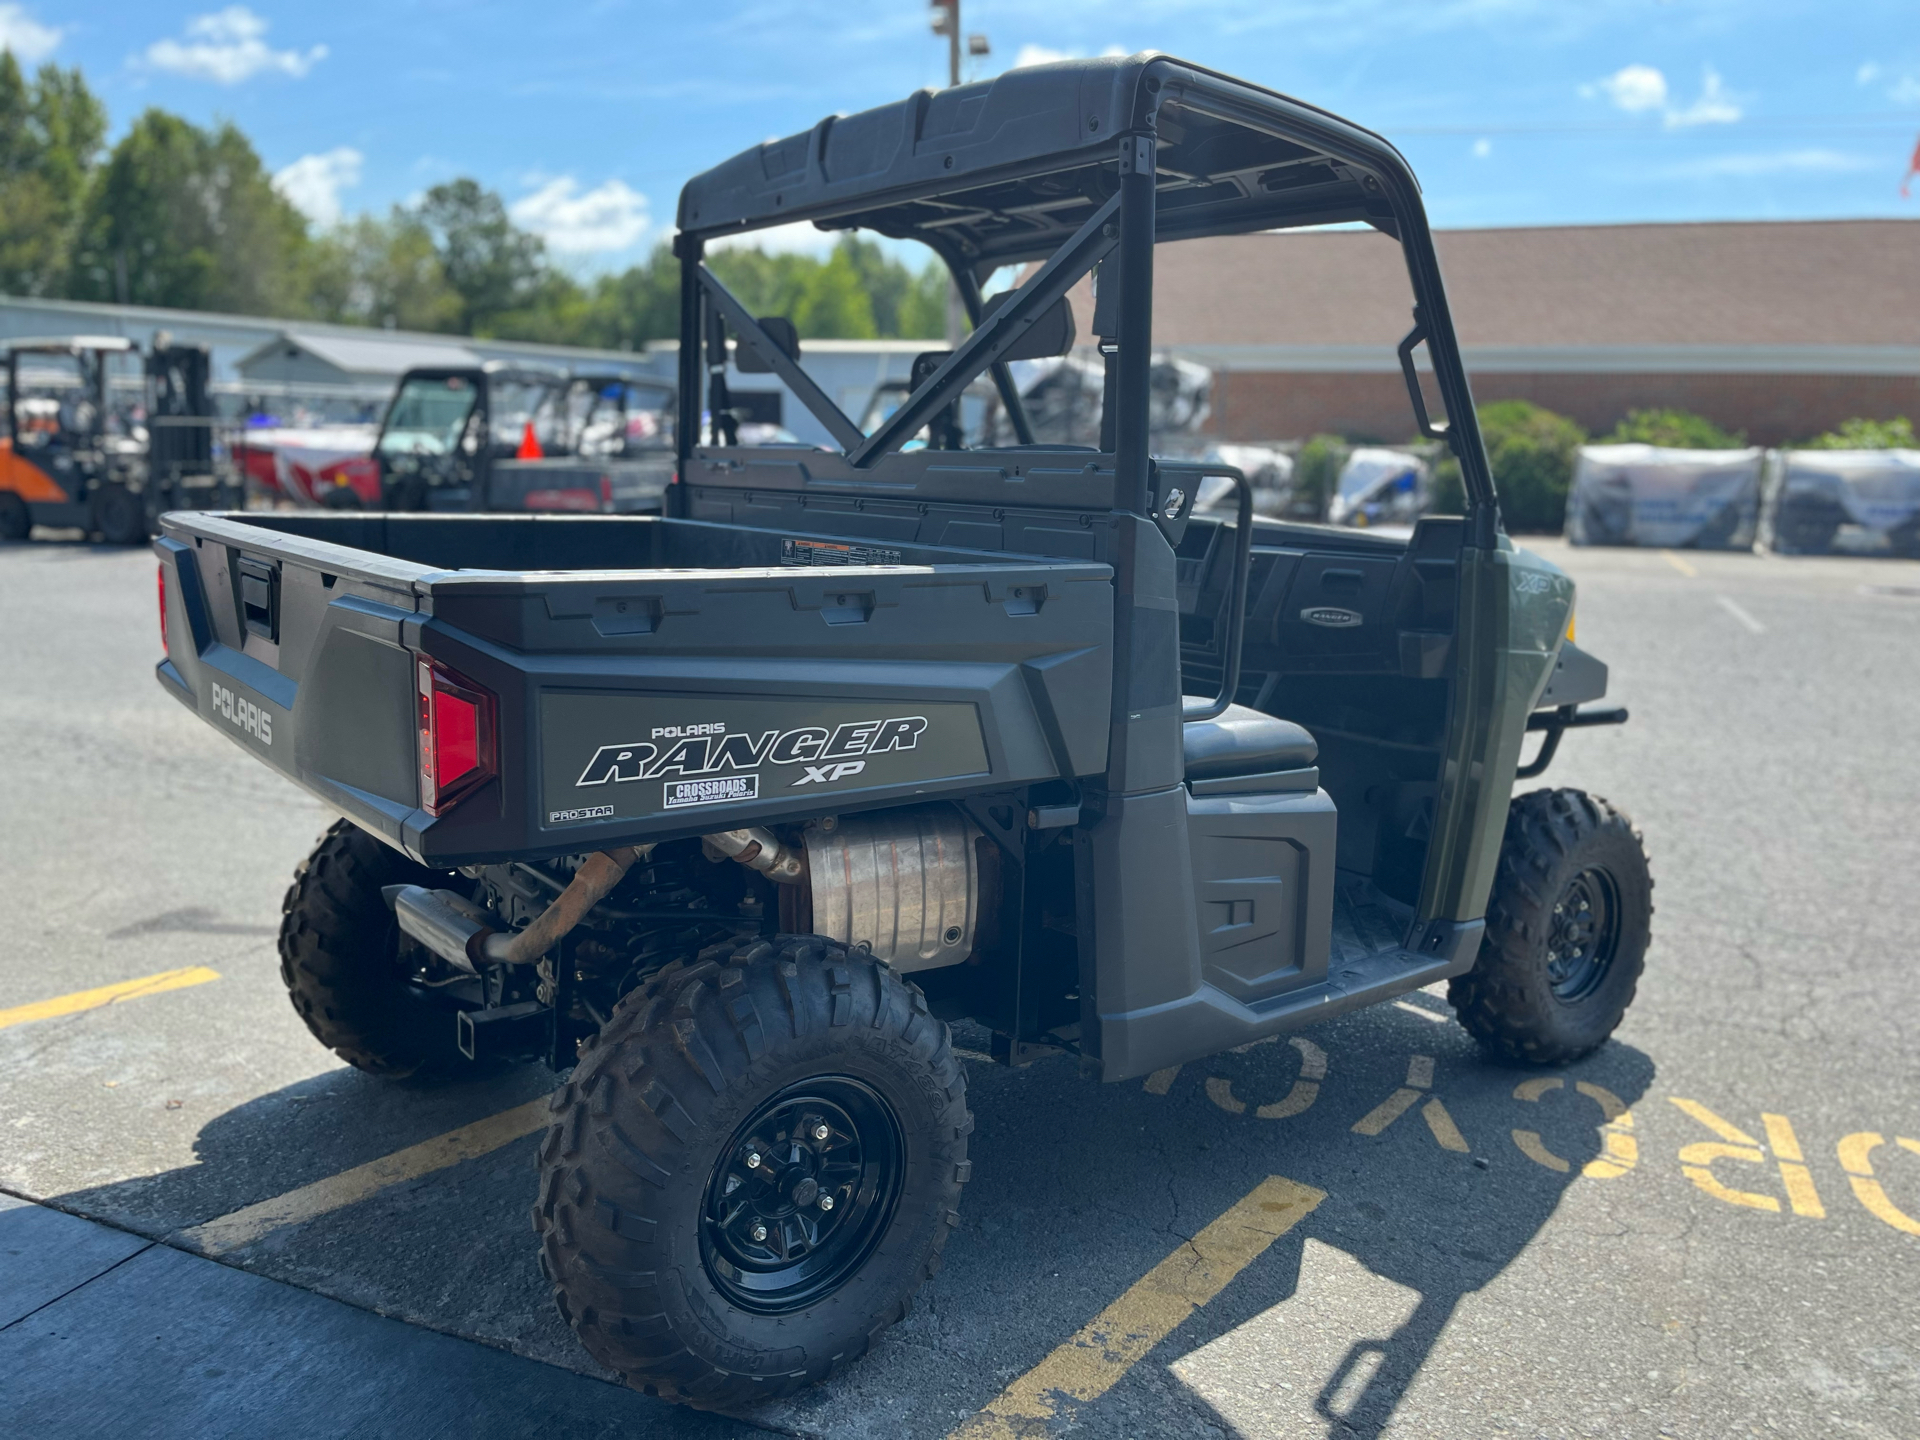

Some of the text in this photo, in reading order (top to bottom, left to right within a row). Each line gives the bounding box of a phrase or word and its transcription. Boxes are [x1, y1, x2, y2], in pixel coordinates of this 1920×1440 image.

[1516, 571, 1551, 594] XP
[212, 682, 272, 746] POLARIS
[651, 722, 726, 740] POLARIS
[575, 716, 928, 787] RANGER
[791, 760, 866, 787] XP
[667, 788, 755, 805] Yamaha Suzuki Polaris
[676, 778, 747, 798] CROSSROADS
[550, 804, 614, 822] PROSTAR
